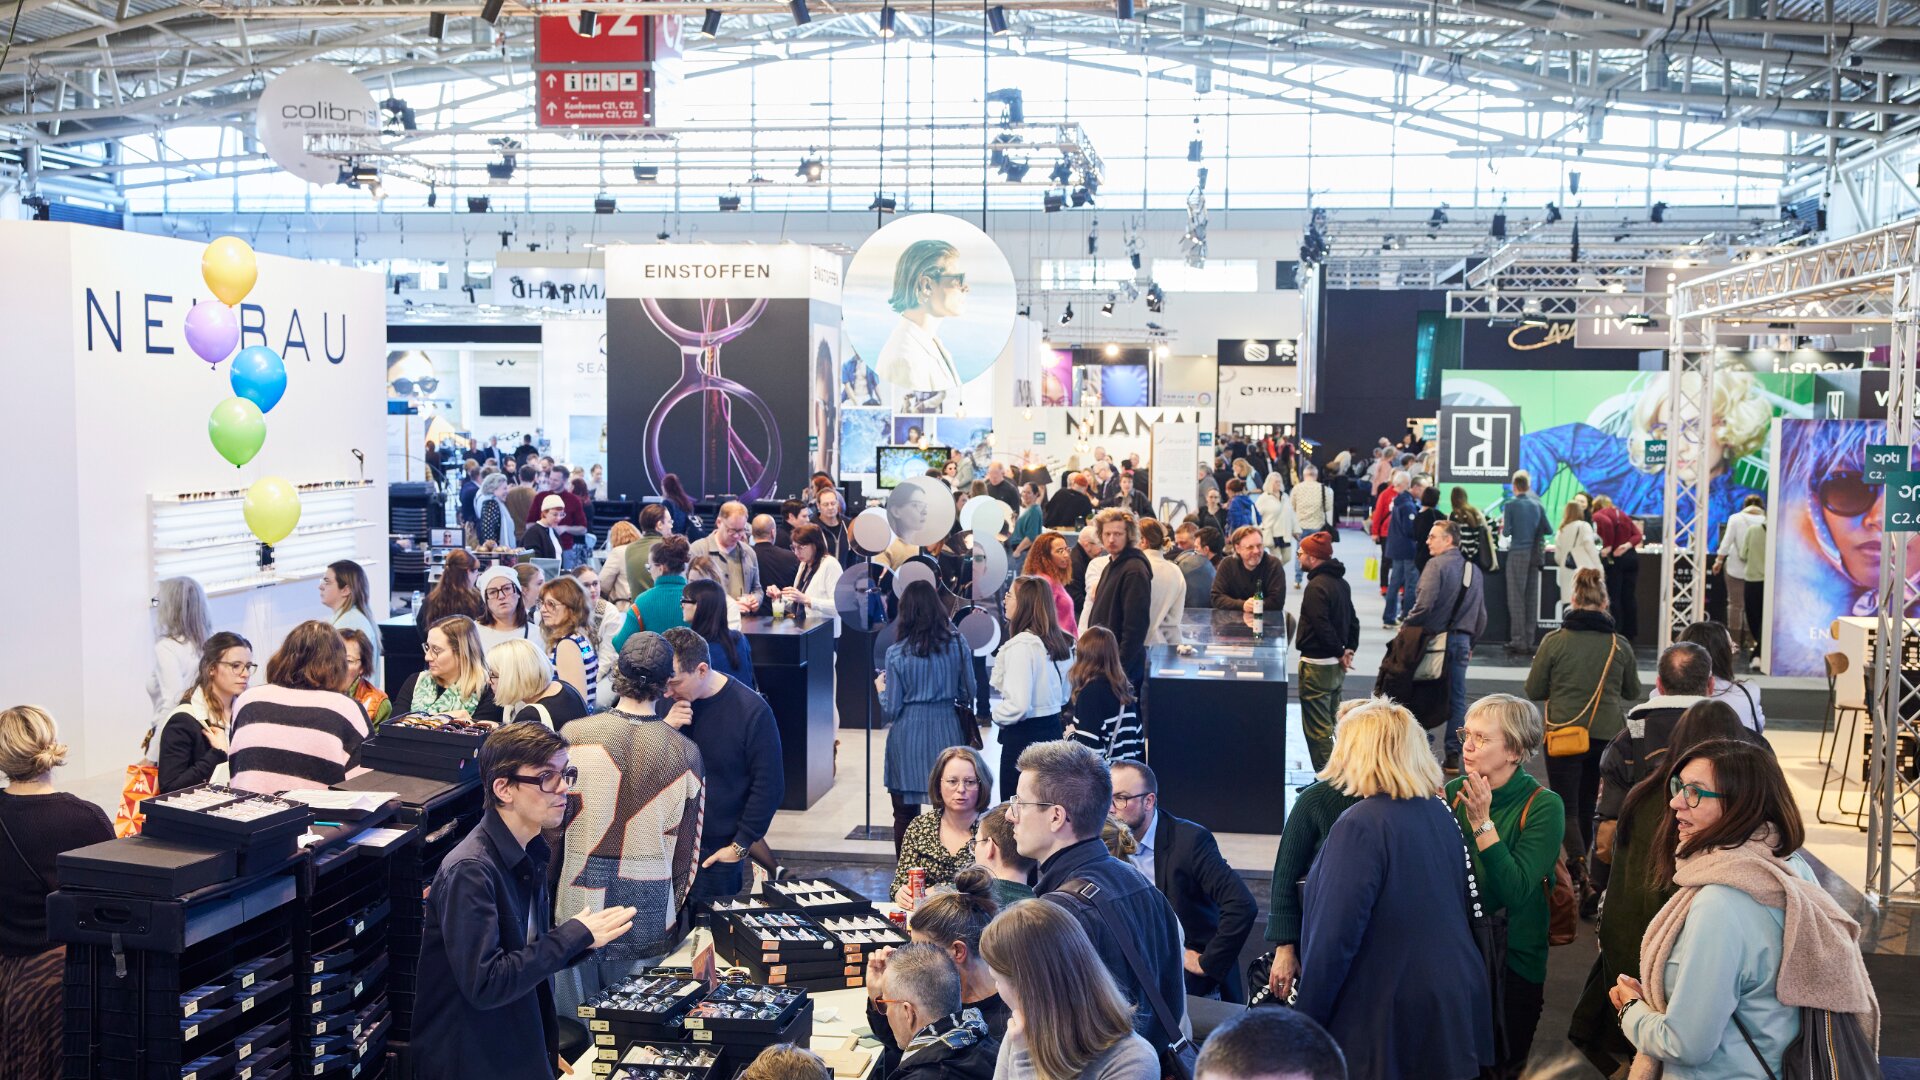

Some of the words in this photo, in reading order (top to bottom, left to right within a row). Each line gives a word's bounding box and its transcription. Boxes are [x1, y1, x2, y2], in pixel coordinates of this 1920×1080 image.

[282, 101, 367, 123] colibri
[563, 101, 601, 111] Konferenz
[602, 101, 618, 111] C21,
[619, 101, 635, 110] C22
[563, 110, 604, 119] Conference
[605, 110, 621, 120] C21,
[622, 110, 638, 119] C22
[644, 263, 771, 279] EINSTOFFEN
[512, 282, 606, 300] CHARM
[85, 286, 346, 365] NEBAU
[1872, 451, 1900, 466] opti
[1451, 469, 1484, 477] VARIATION
[1868, 470, 1886, 480] C2.
